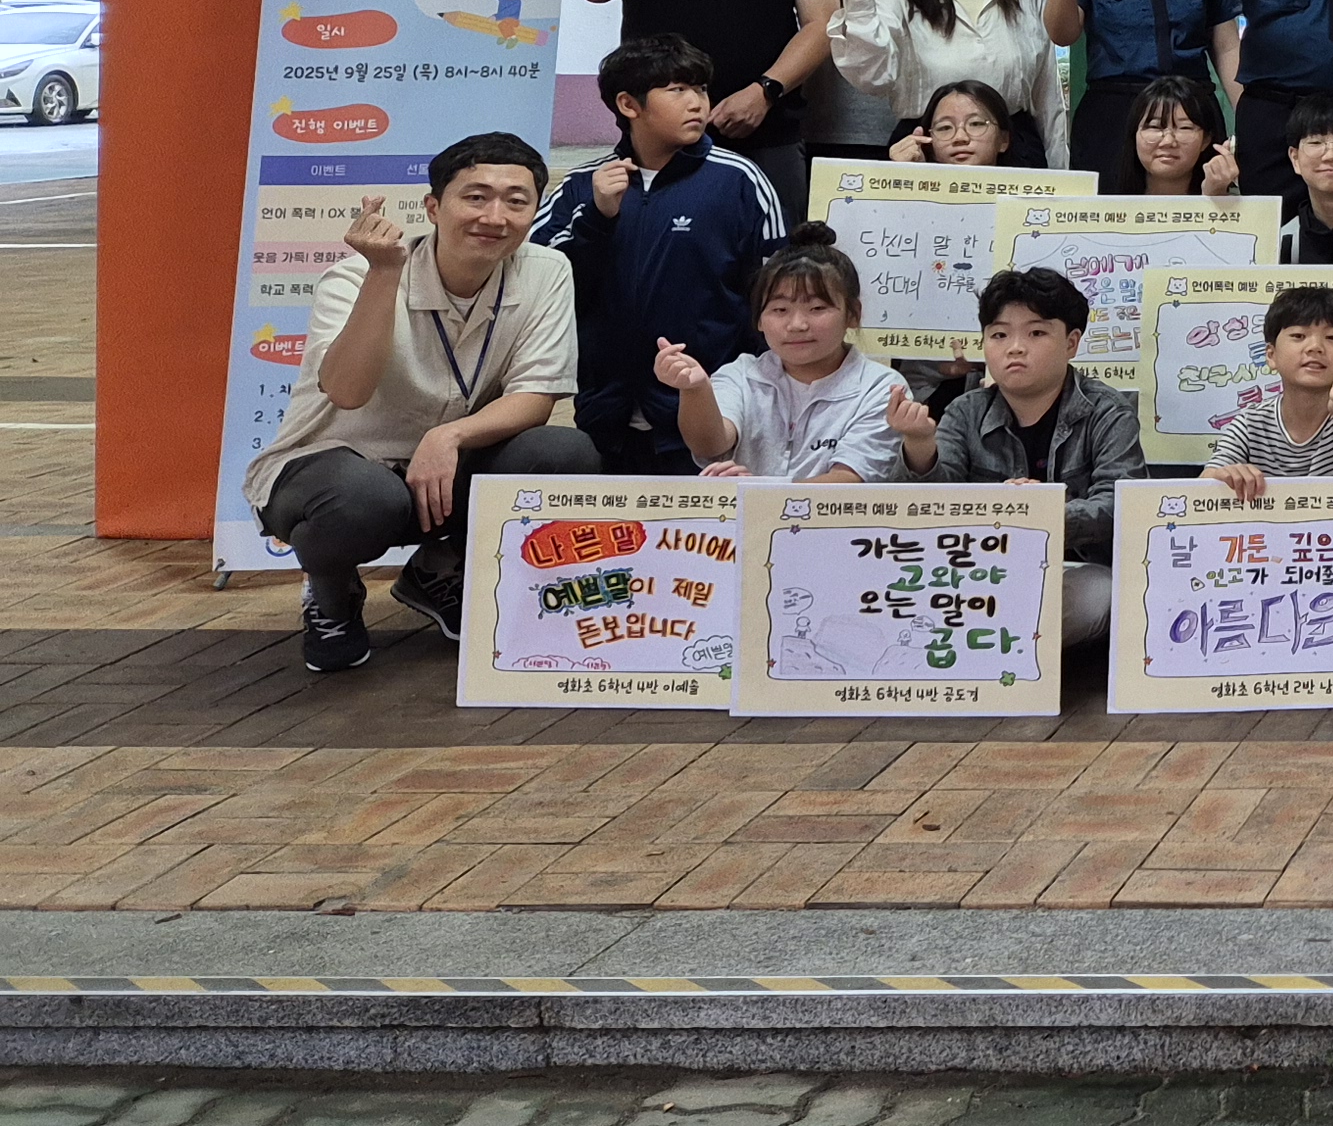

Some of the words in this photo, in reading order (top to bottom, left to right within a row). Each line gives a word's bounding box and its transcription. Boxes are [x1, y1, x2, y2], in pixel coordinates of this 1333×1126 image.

[316, 24, 345, 40] 일시
[283, 65, 338, 80] 2025년
[344, 65, 368, 82] 9월
[373, 64, 406, 80] 25일
[413, 63, 438, 81] (목)
[508, 62, 540, 79] 40분
[292, 119, 325, 134] 진행
[333, 119, 378, 133] 이벤트
[311, 165, 346, 176] 이벤트
[869, 178, 914, 191] 언어폭력
[918, 180, 941, 192] 예방
[949, 182, 982, 194] 슬로건
[986, 183, 1019, 195] 공모전
[262, 208, 286, 219] 언어
[292, 207, 316, 218] 폭력
[328, 208, 346, 218] OX
[859, 230, 918, 258] 당신의
[933, 235, 951, 257] 말
[963, 235, 979, 258] 한
[253, 253, 277, 263] 웃음
[261, 284, 285, 296] 학교
[290, 284, 313, 295] 폭력
[871, 271, 921, 300] 상대의
[1192, 282, 1234, 292] 언어폭력
[1238, 282, 1258, 292] 예방
[259, 341, 304, 356] 이벤트
[877, 337, 910, 349] 영화초
[914, 336, 946, 349] 6학년
[548, 495, 597, 508] 언어폭력
[602, 495, 628, 508] 예방
[636, 495, 673, 509] 슬로건
[678, 496, 713, 509] 공모전
[1193, 497, 1244, 511] 언어폭력
[1284, 496, 1322, 510] 슬로건
[610, 524, 638, 552] 말
[850, 534, 925, 562] 가는
[937, 533, 1008, 567] 말이
[1170, 536, 1198, 568] 날
[887, 565, 1007, 591] 고와야
[1206, 567, 1269, 588] 연고가
[672, 577, 714, 608] 제일
[859, 591, 916, 619] 오는
[931, 593, 996, 627] 말이
[576, 613, 696, 650] 돋보입니다
[557, 680, 593, 693] 영화초
[598, 680, 632, 693] 6학년
[636, 680, 658, 694] 4반
[663, 679, 699, 696] 이예솔
[1211, 682, 1248, 698] 영화초
[1253, 681, 1289, 696] 6학년
[1294, 680, 1315, 695] 2반
